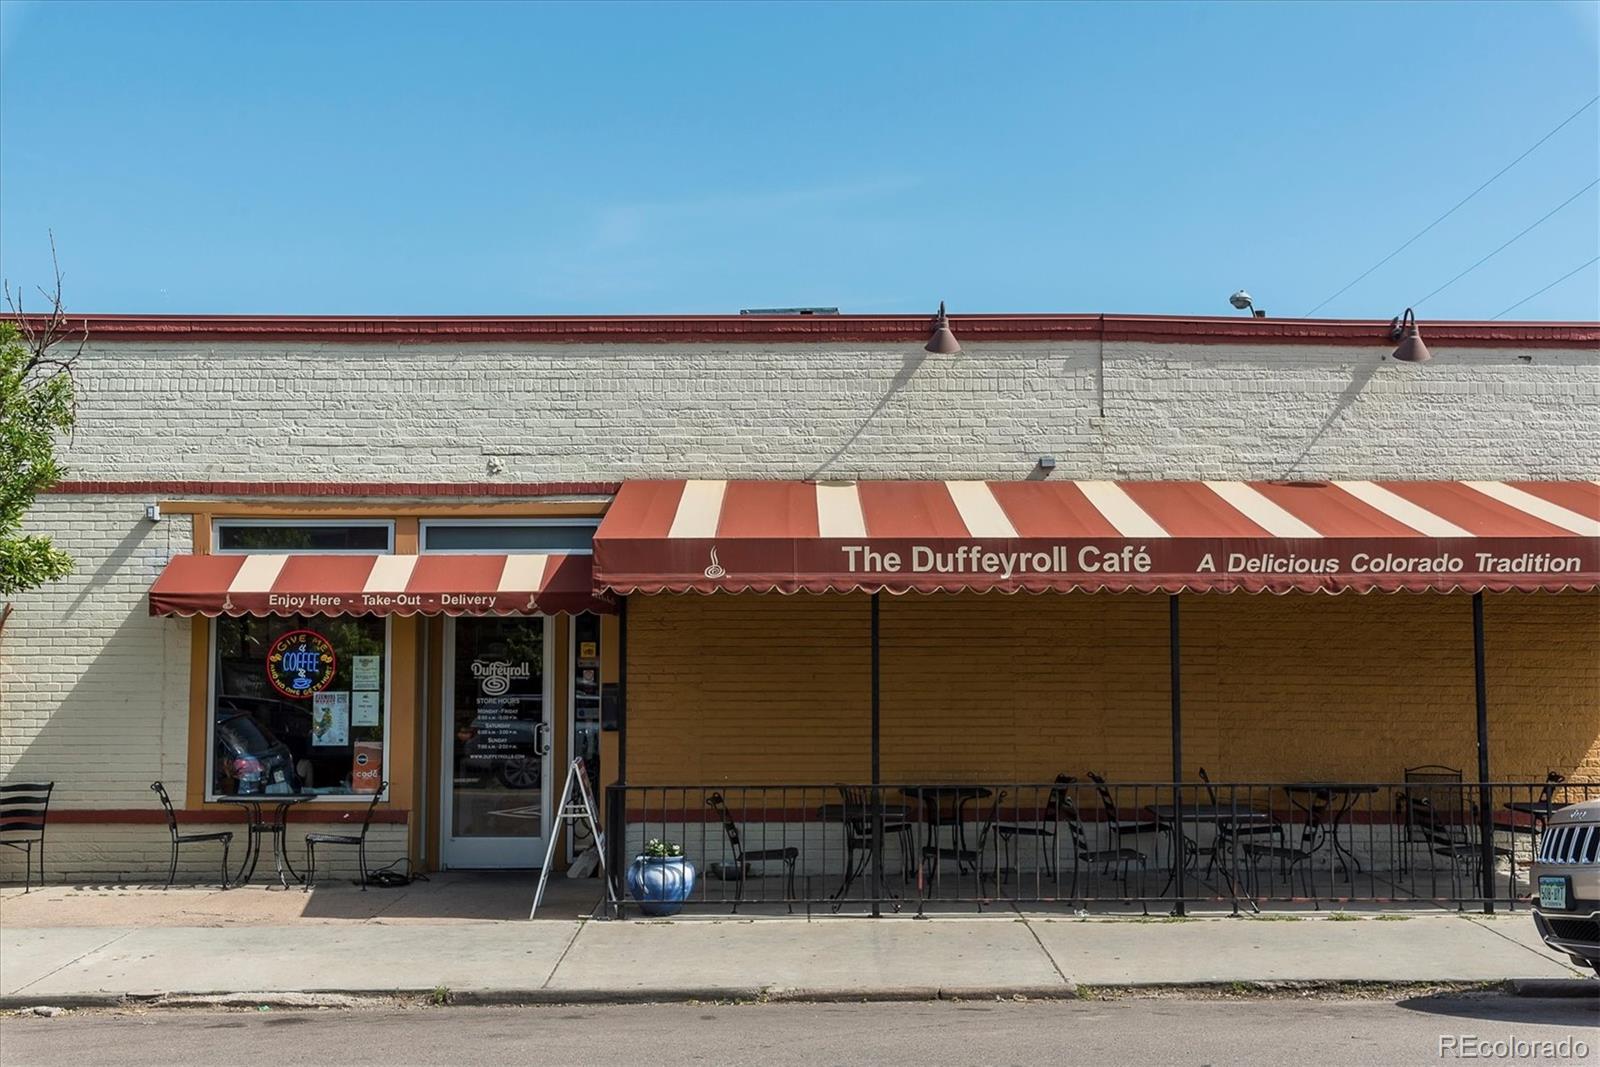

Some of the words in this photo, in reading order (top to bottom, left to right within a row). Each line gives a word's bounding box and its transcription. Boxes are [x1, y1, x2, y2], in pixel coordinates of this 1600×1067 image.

[841, 545, 902, 573] The
[912, 545, 1068, 579] Duffeyroll
[1078, 545, 1153, 573] Café
[1196, 552, 1217, 573] A
[1227, 552, 1340, 574] Delicious
[1350, 552, 1464, 574] Colorado
[1474, 552, 1582, 574] Tradition
[269, 594, 306, 609] Enjoy
[310, 594, 341, 606] Here
[361, 594, 421, 606] Take-Out
[441, 593, 497, 607] Delivery
[277, 635, 307, 651] GIVE
[312, 638, 328, 652] ME
[283, 652, 320, 672] COFFEE
[471, 659, 531, 680] Duffeyroll
